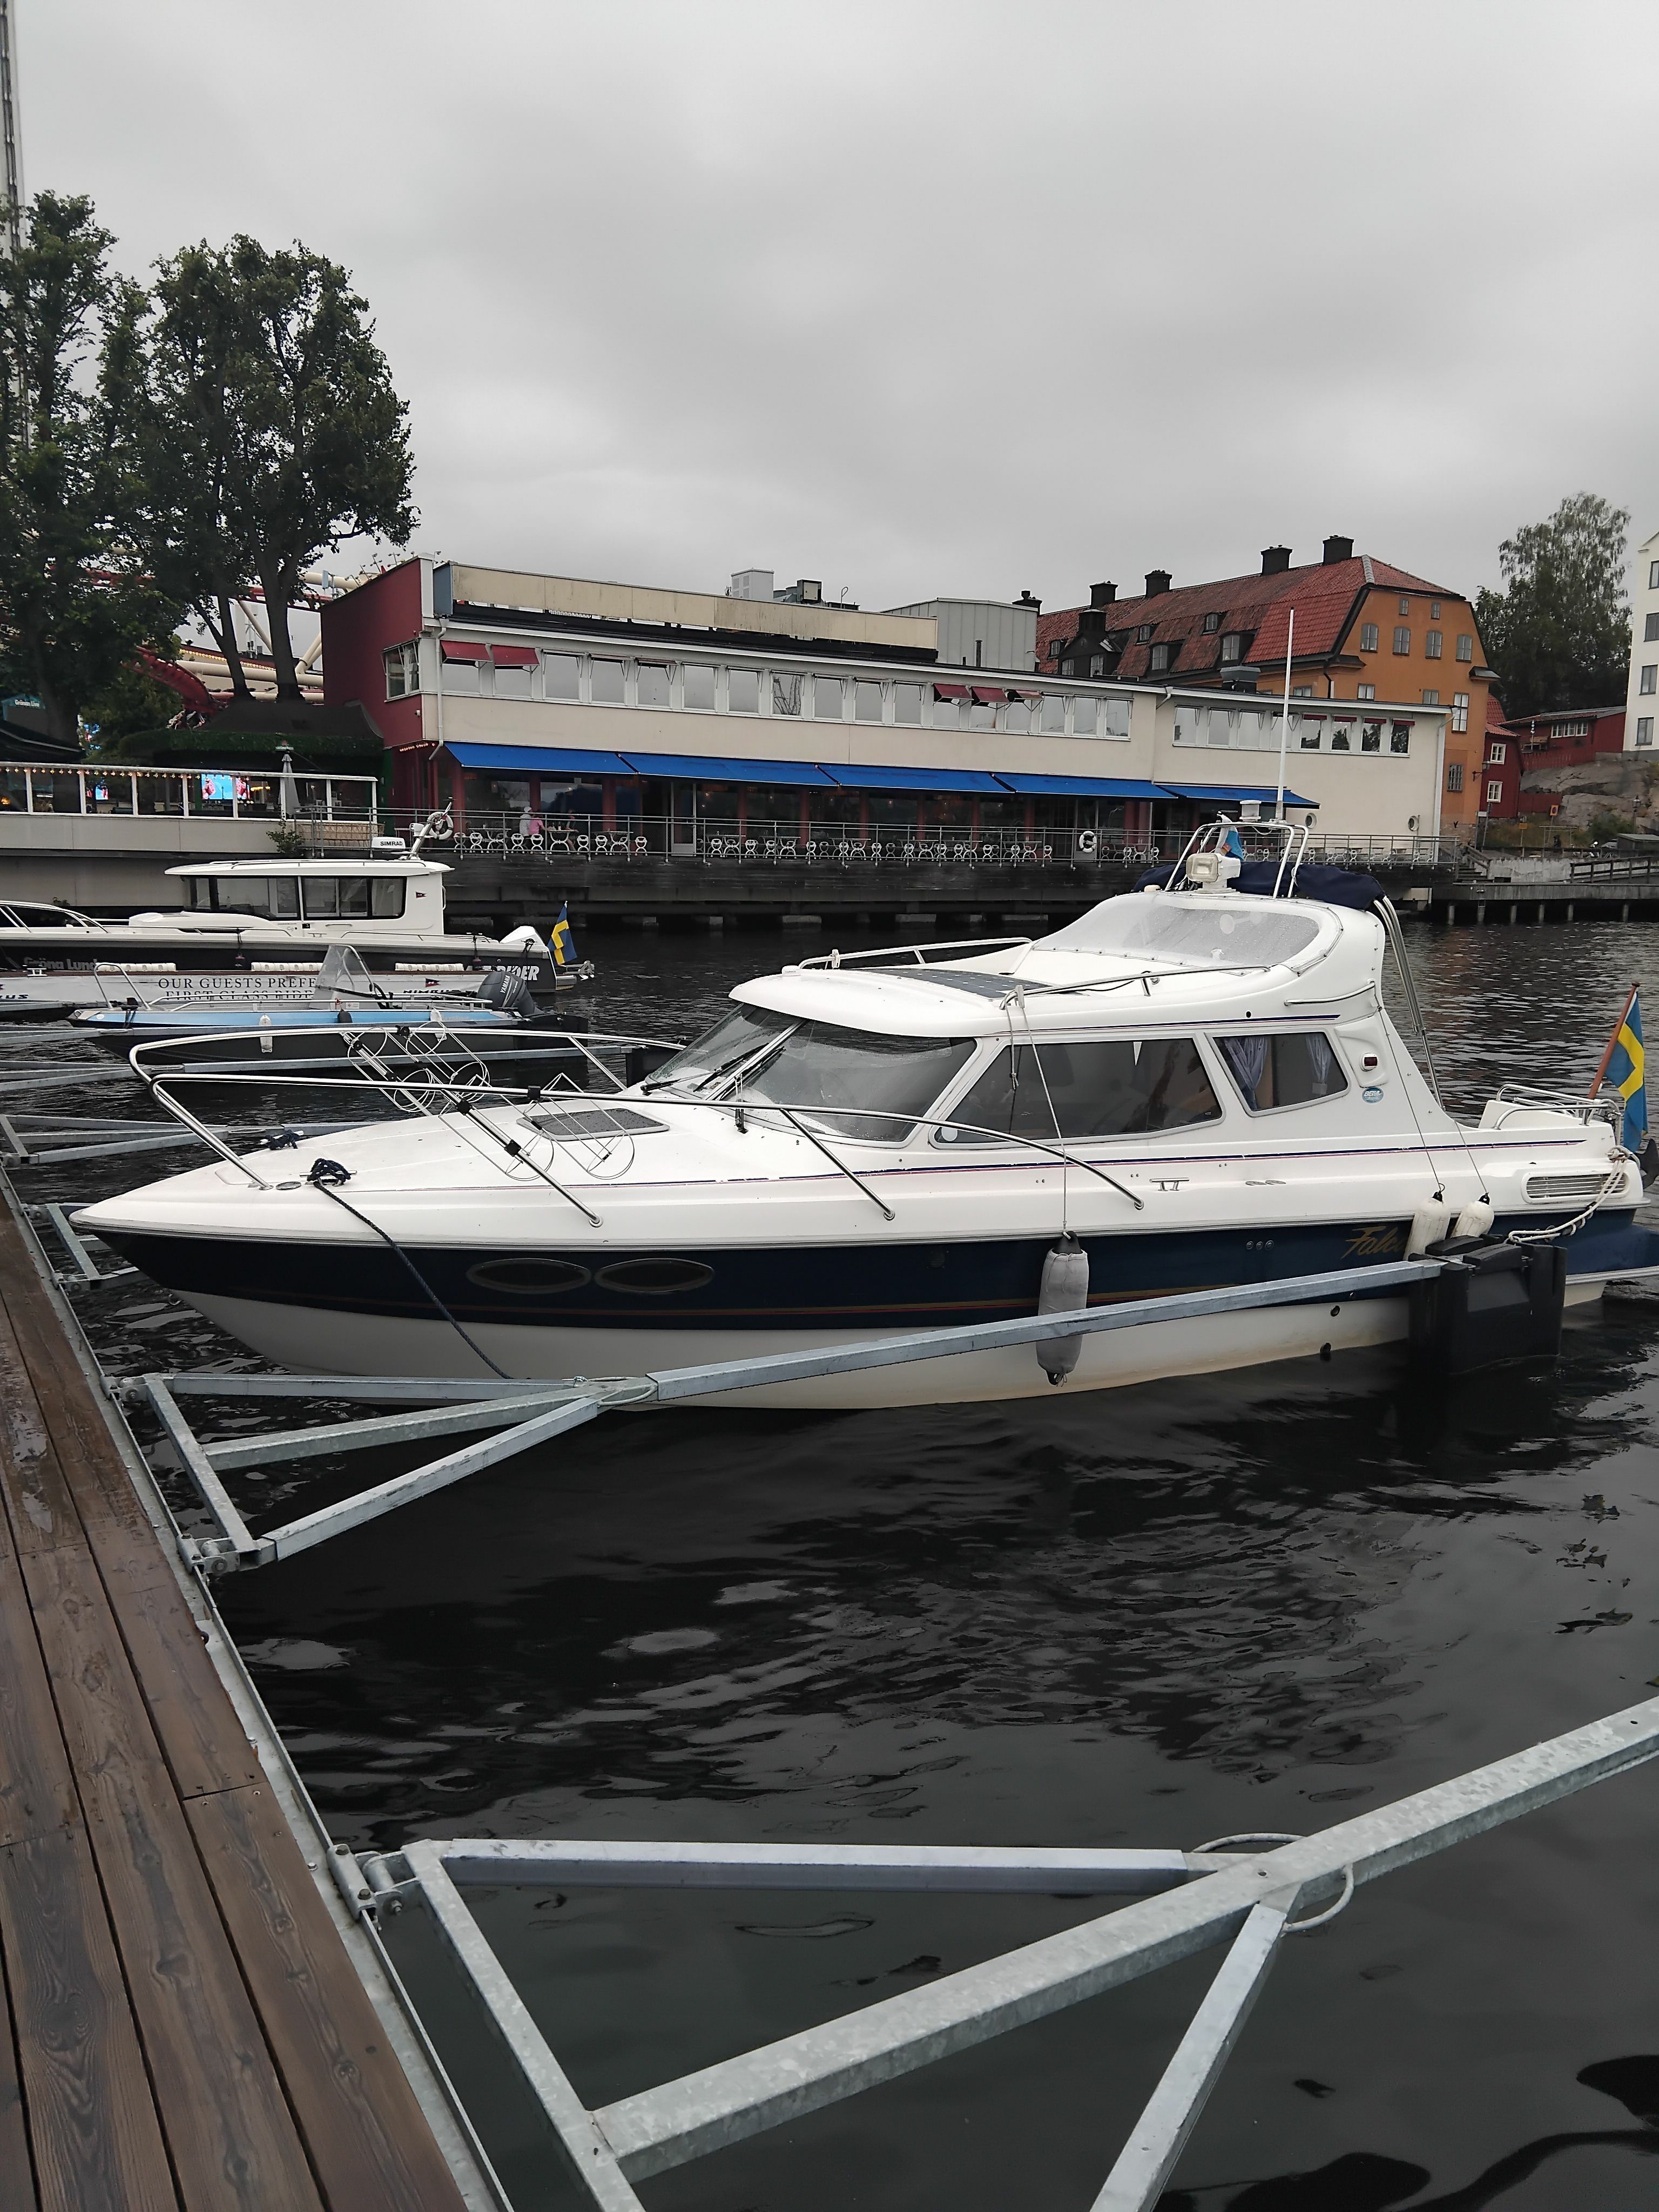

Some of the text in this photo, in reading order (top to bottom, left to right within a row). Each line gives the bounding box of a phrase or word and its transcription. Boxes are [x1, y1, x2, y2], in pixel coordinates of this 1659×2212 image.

[66, 959, 97, 970] Lund
[158, 978, 193, 988] OUR
[199, 978, 262, 988] GUESTS
[500, 975, 511, 994] YAMAHA
[165, 990, 213, 1000] FIRST
[219, 990, 268, 1000] CLASS
[1340, 1226, 1406, 1260] Falco
